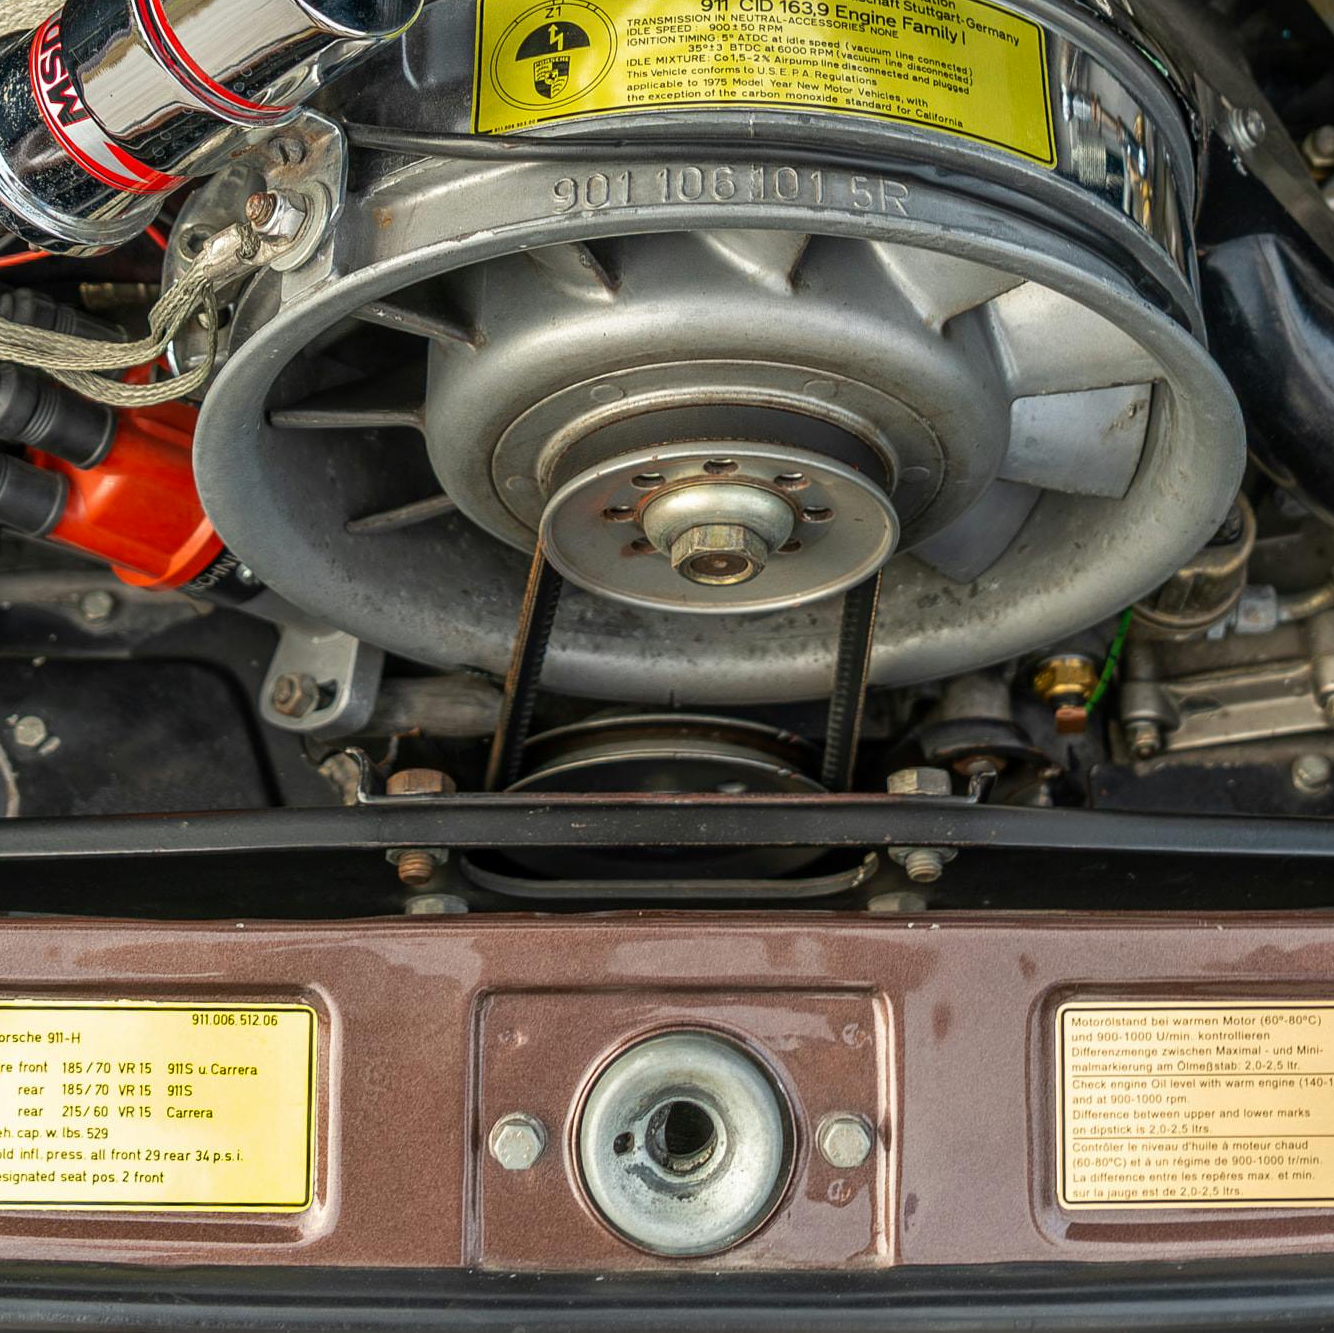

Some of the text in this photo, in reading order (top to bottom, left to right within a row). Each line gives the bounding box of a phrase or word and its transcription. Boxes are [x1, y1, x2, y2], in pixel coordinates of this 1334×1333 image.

[628, 15, 711, 26] TRANSMISSION
[871, 27, 898, 38] NONE
[836, 5, 896, 27] Engine
[903, 16, 957, 43] Family
[904, 1, 1019, 46] Stuttgart-Germany
[627, 28, 651, 36] IDLE
[627, 70, 647, 78] This
[651, 69, 687, 77] Vehicle
[815, 71, 877, 86] Regulations
[627, 80, 683, 91] applicable
[733, 78, 763, 86] Model
[770, 80, 792, 88] Year
[798, 82, 819, 91] New
[825, 83, 852, 94] Motor
[907, 97, 928, 108] with
[649, 90, 701, 101] exception
[742, 90, 780, 98] carbon
[785, 92, 838, 103] monoxide
[846, 97, 891, 111] standard
[897, 105, 910, 115] for
[916, 109, 963, 128] California
[552, 165, 909, 216] 901 106 101 5R
[48, 1032, 80, 1044] 911-H
[1072, 1030, 1270, 1042] und 900-1000 kontrollieren
[1072, 1045, 1293, 1058] Differenzmenge zwischen Maximal und
[19, 1061, 48, 1074] front
[167, 1063, 193, 1075] 911S
[211, 1063, 257, 1076] Carrera
[1072, 1061, 1152, 1073] malmarkierung
[1072, 1078, 1295, 1091] Check engine Oil level with warm engine
[18, 1085, 44, 1095] rear
[167, 1085, 192, 1097] 911S
[1072, 1094, 1162, 1104] and at 900-1000
[18, 1107, 43, 1117] rear
[167, 1107, 213, 1119] Carrera
[1072, 1108, 1310, 1121] Difference between upper and lower marks
[87, 1128, 108, 1139] 529
[1073, 1124, 1145, 1136] on dipstick is
[90, 1150, 106, 1160] all
[111, 1150, 141, 1161] front
[145, 1150, 161, 1161] 29
[163, 1151, 191, 1161] rear
[195, 1150, 210, 1161] 34
[61, 1172, 87, 1183] seat
[123, 1172, 130, 1183] 2
[134, 1172, 164, 1184] front
